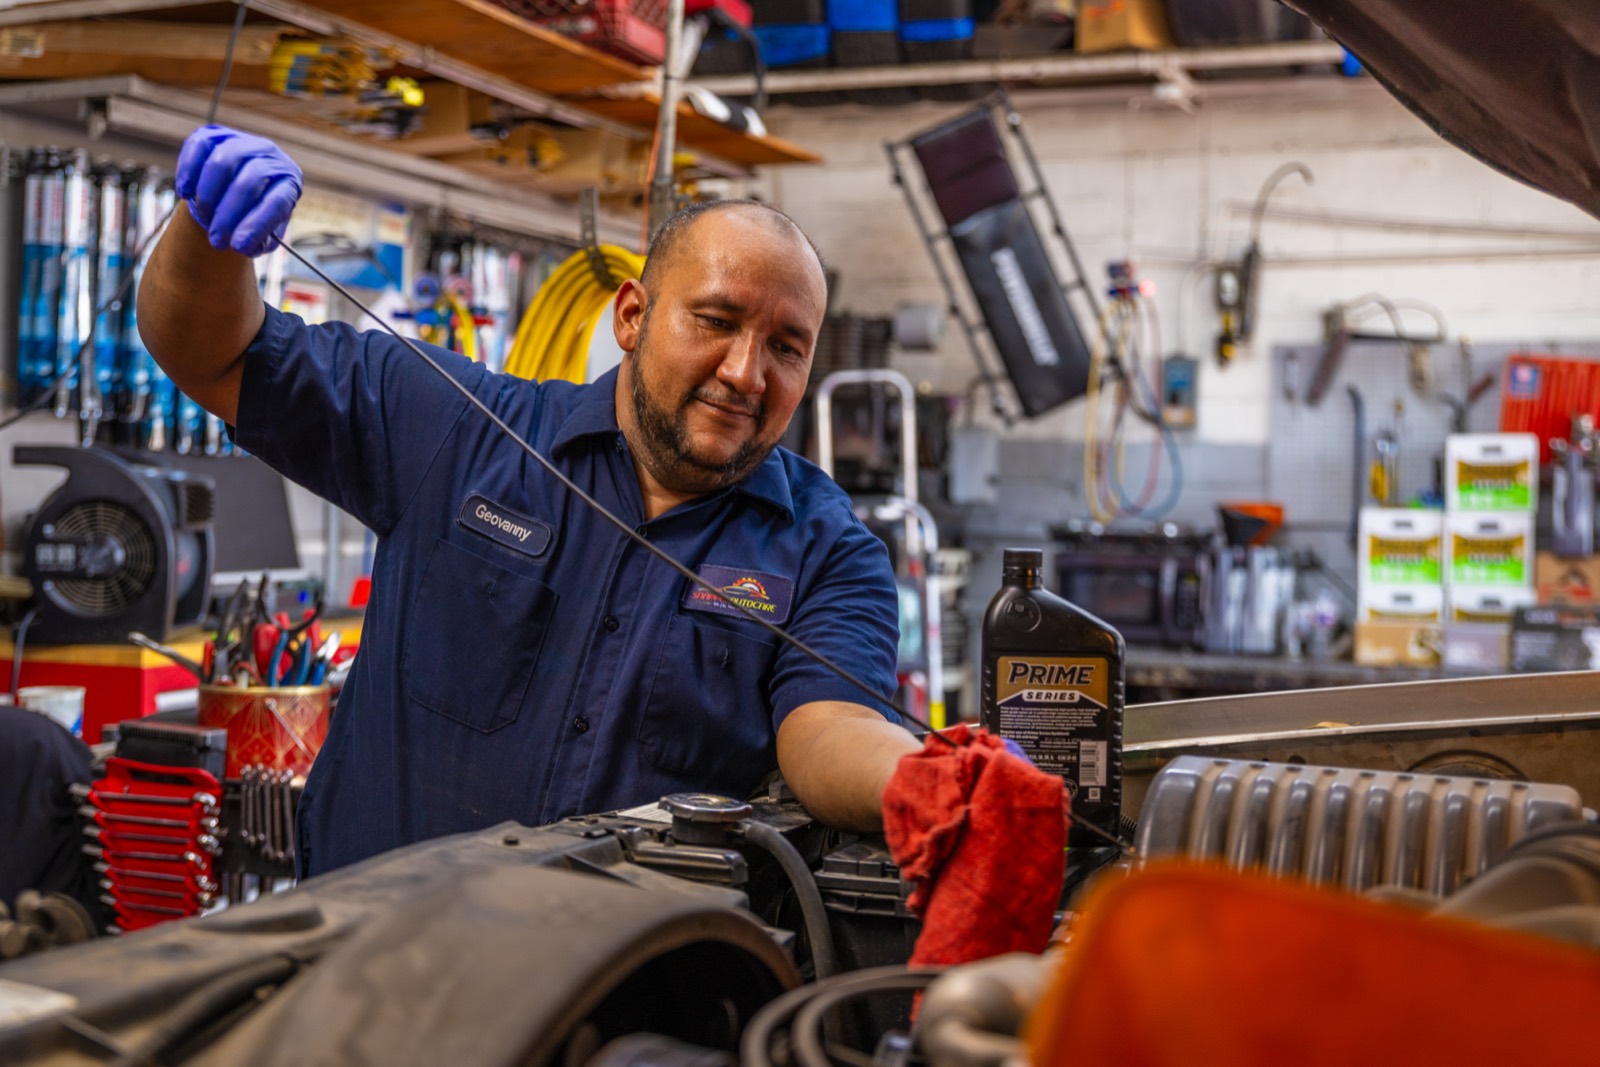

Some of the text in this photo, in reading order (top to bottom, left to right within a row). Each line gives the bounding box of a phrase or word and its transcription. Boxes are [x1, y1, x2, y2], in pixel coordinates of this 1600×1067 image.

[475, 504, 532, 542] Geovanny
[1008, 662, 1095, 684] PRIME
[1026, 691, 1076, 700] SERIES
